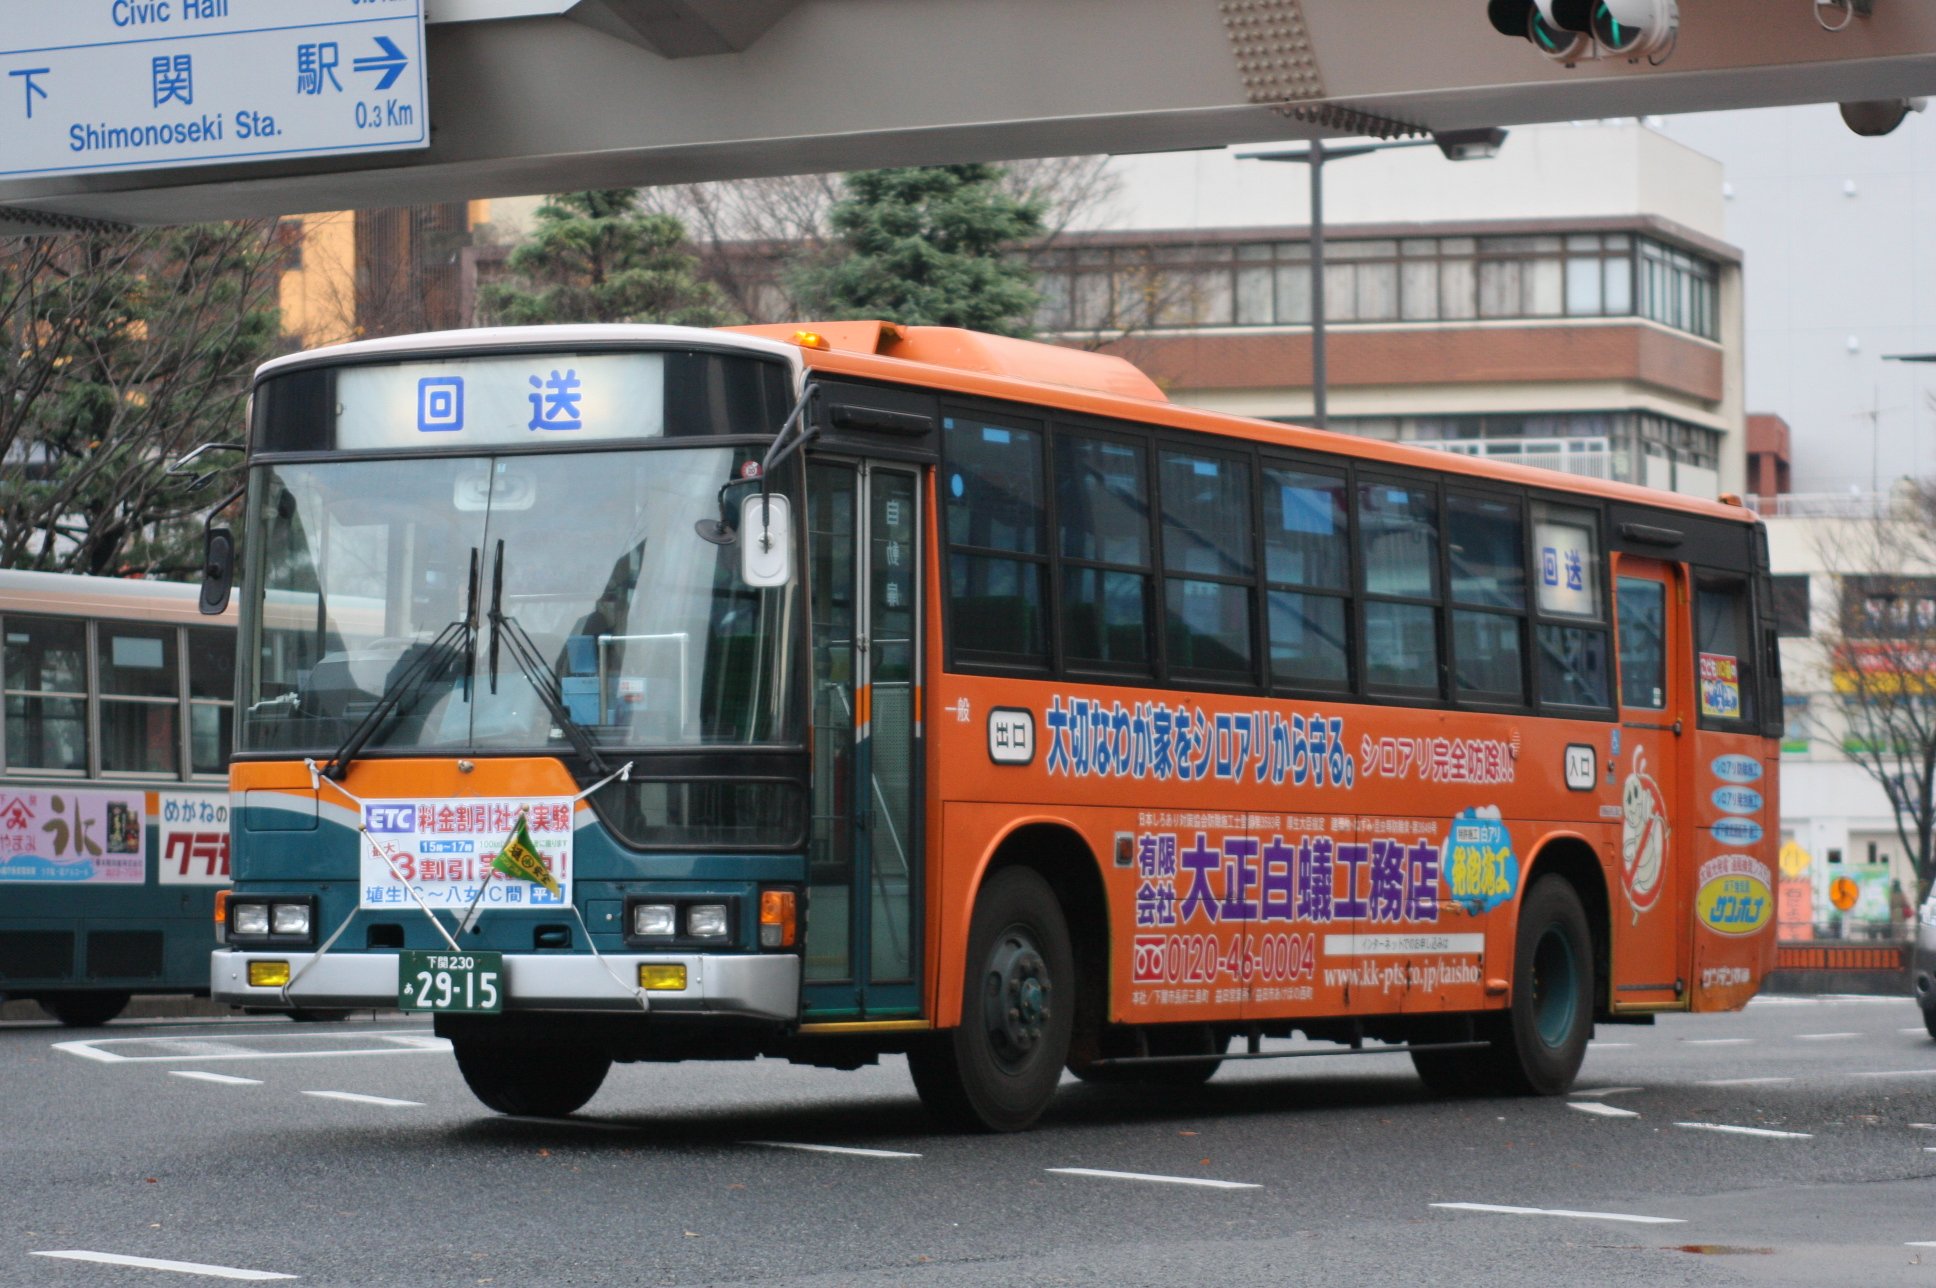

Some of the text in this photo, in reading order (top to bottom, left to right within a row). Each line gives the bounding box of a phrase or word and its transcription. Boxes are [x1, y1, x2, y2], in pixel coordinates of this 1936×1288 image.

[8, 41, 343, 120] 下関駅
[69, 110, 283, 152] Shimonoseki Sta.
[417, 368, 582, 432] 回送
[1542, 547, 1583, 591] 回送
[944, 697, 970, 723] 一般
[996, 720, 1027, 750] 出口
[1046, 694, 1354, 791] 大切なわが家をシロアリから守る。
[1570, 755, 1589, 777] 入口
[165, 798, 228, 823] めがねの
[368, 807, 413, 829] ETC
[1136, 831, 1178, 880] 有限
[1180, 831, 1440, 924] 大正白蟻工務店
[1136, 879, 1177, 927] 会社
[1166, 933, 1315, 984] 0120-46-0004
[403, 971, 498, 1009] あ 29-15
